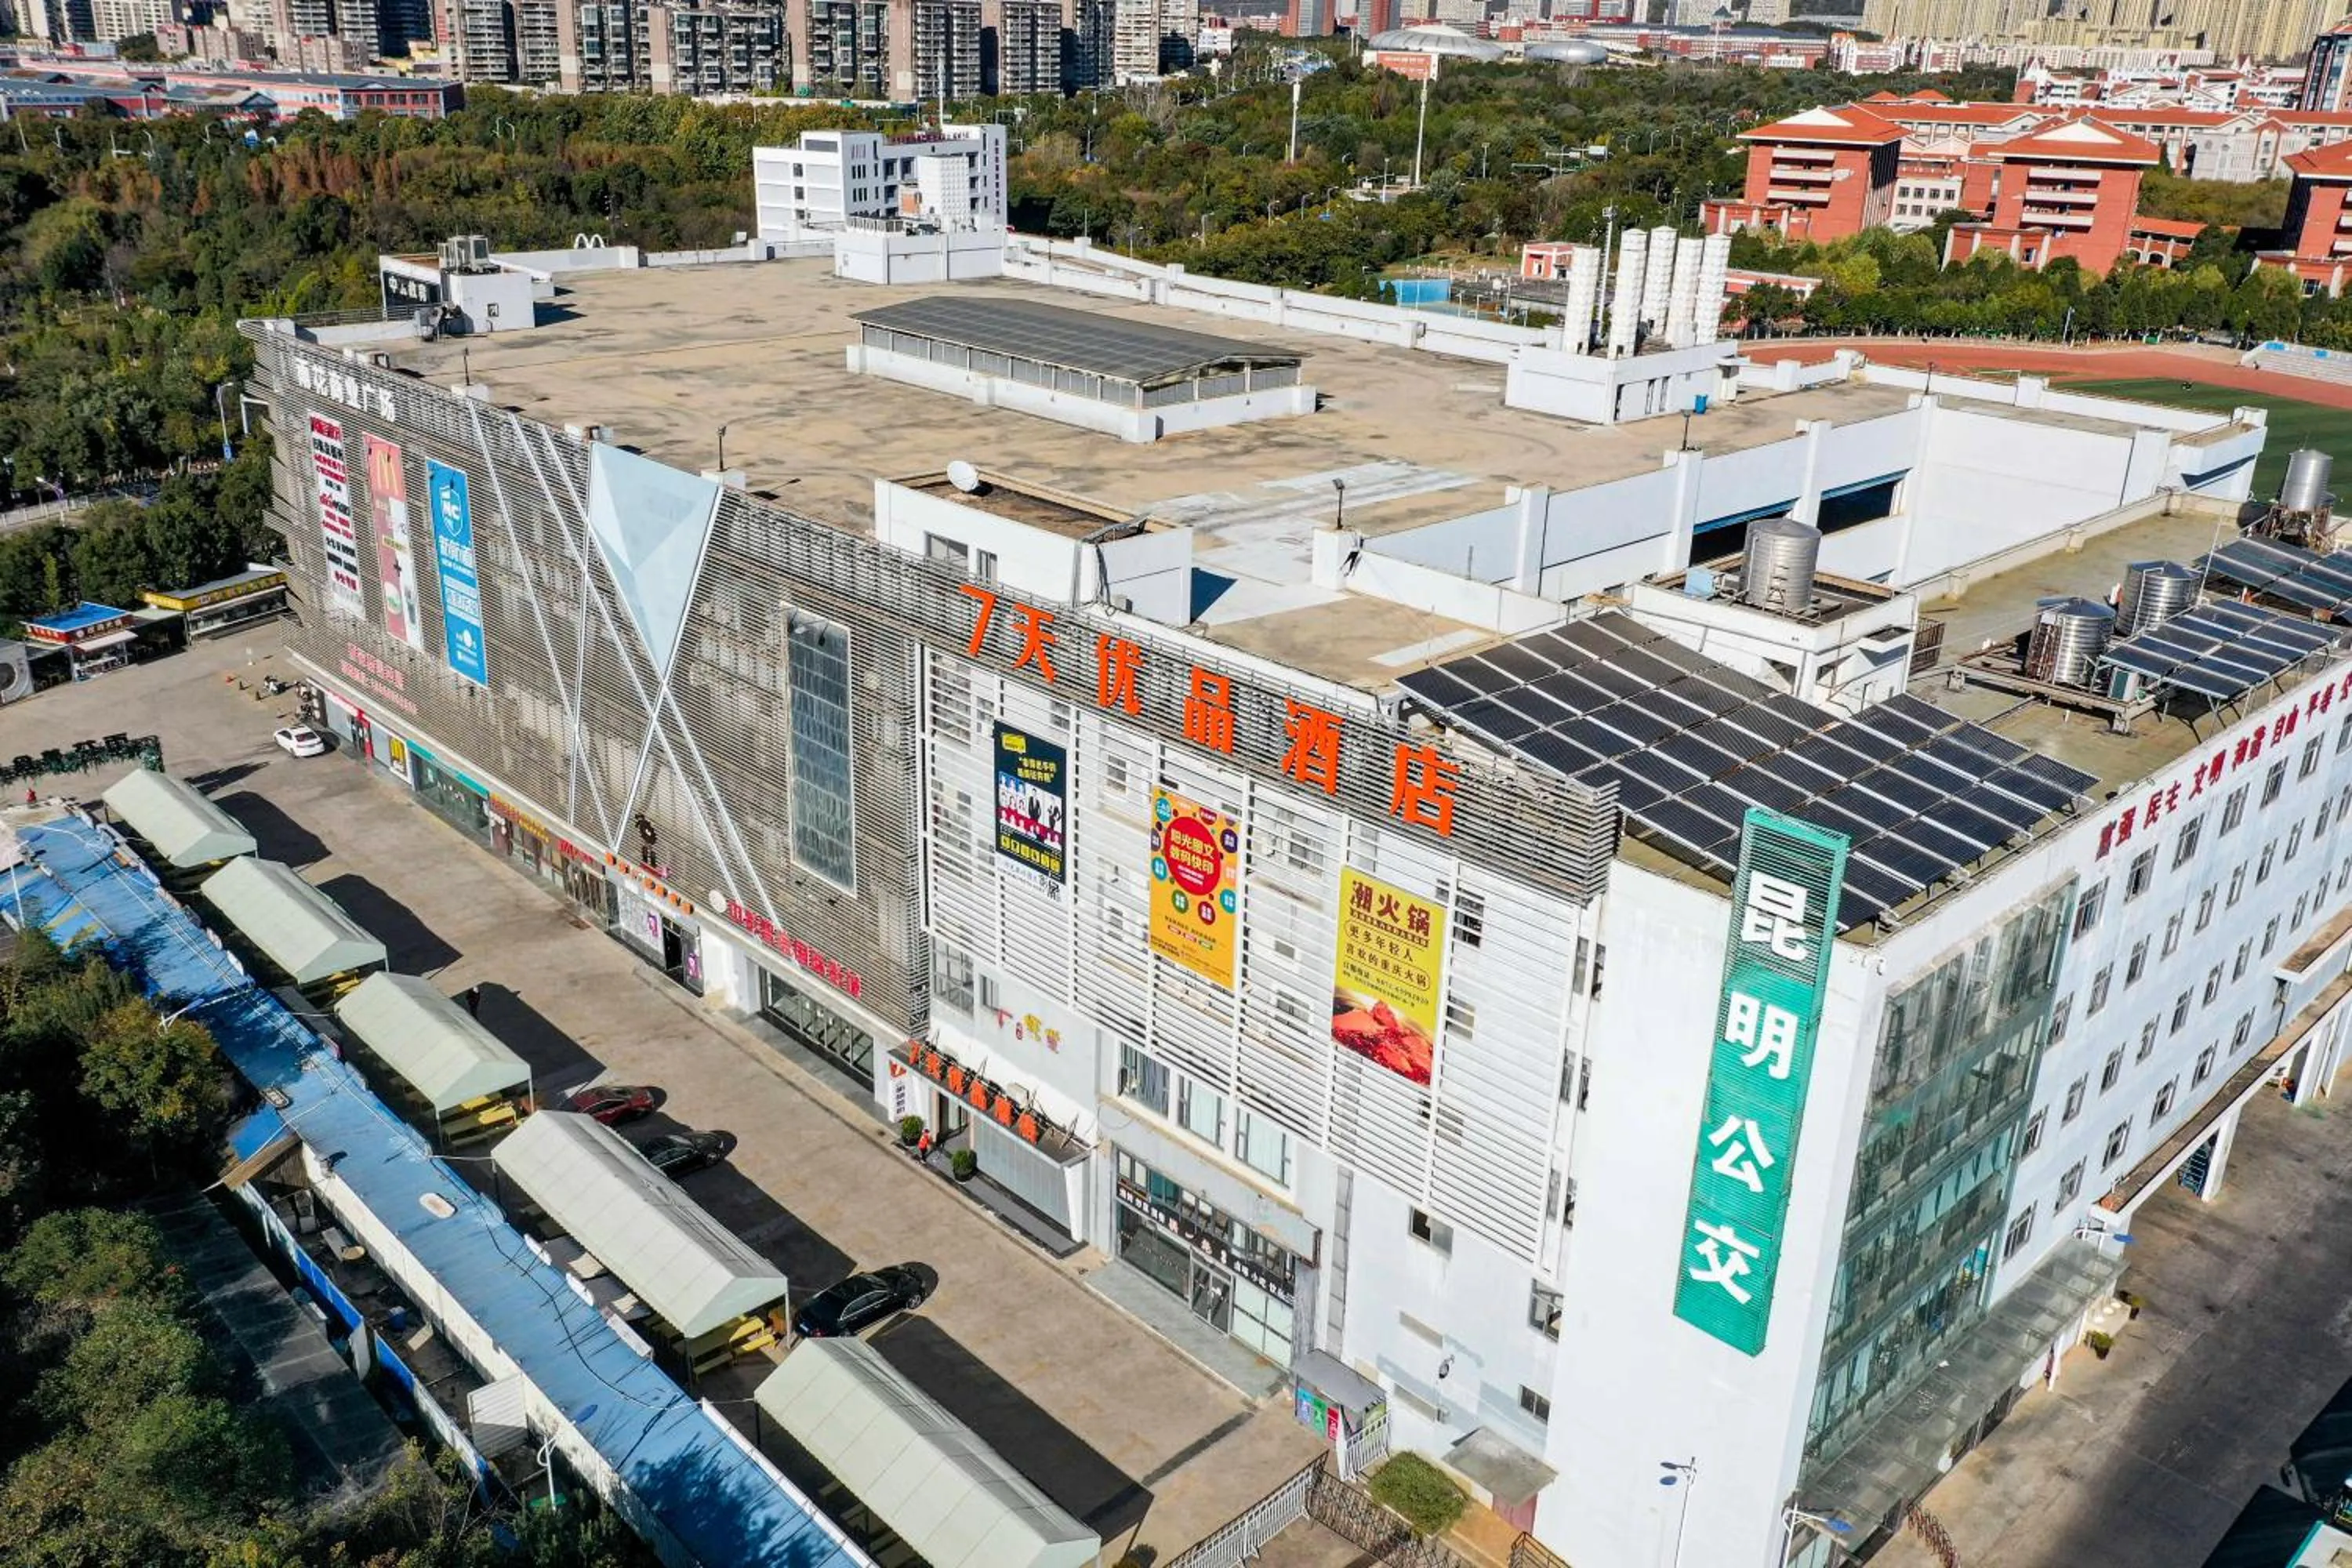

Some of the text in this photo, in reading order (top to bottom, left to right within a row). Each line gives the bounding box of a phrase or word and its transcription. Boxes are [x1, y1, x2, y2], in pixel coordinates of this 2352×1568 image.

[959, 584, 1459, 837] 7天优品酒店
[2095, 805, 2136, 862] 富强
[2143, 779, 2182, 829] 民主
[2189, 749, 2227, 800] 文明
[2232, 725, 2267, 771] 和谐
[2270, 704, 2299, 747] 自由
[2305, 683, 2336, 724] 平等
[1348, 924, 1414, 963] 更多年轻人
[1350, 880, 1431, 937] 潮火锅
[1689, 869, 1810, 1305] 昆明公交
